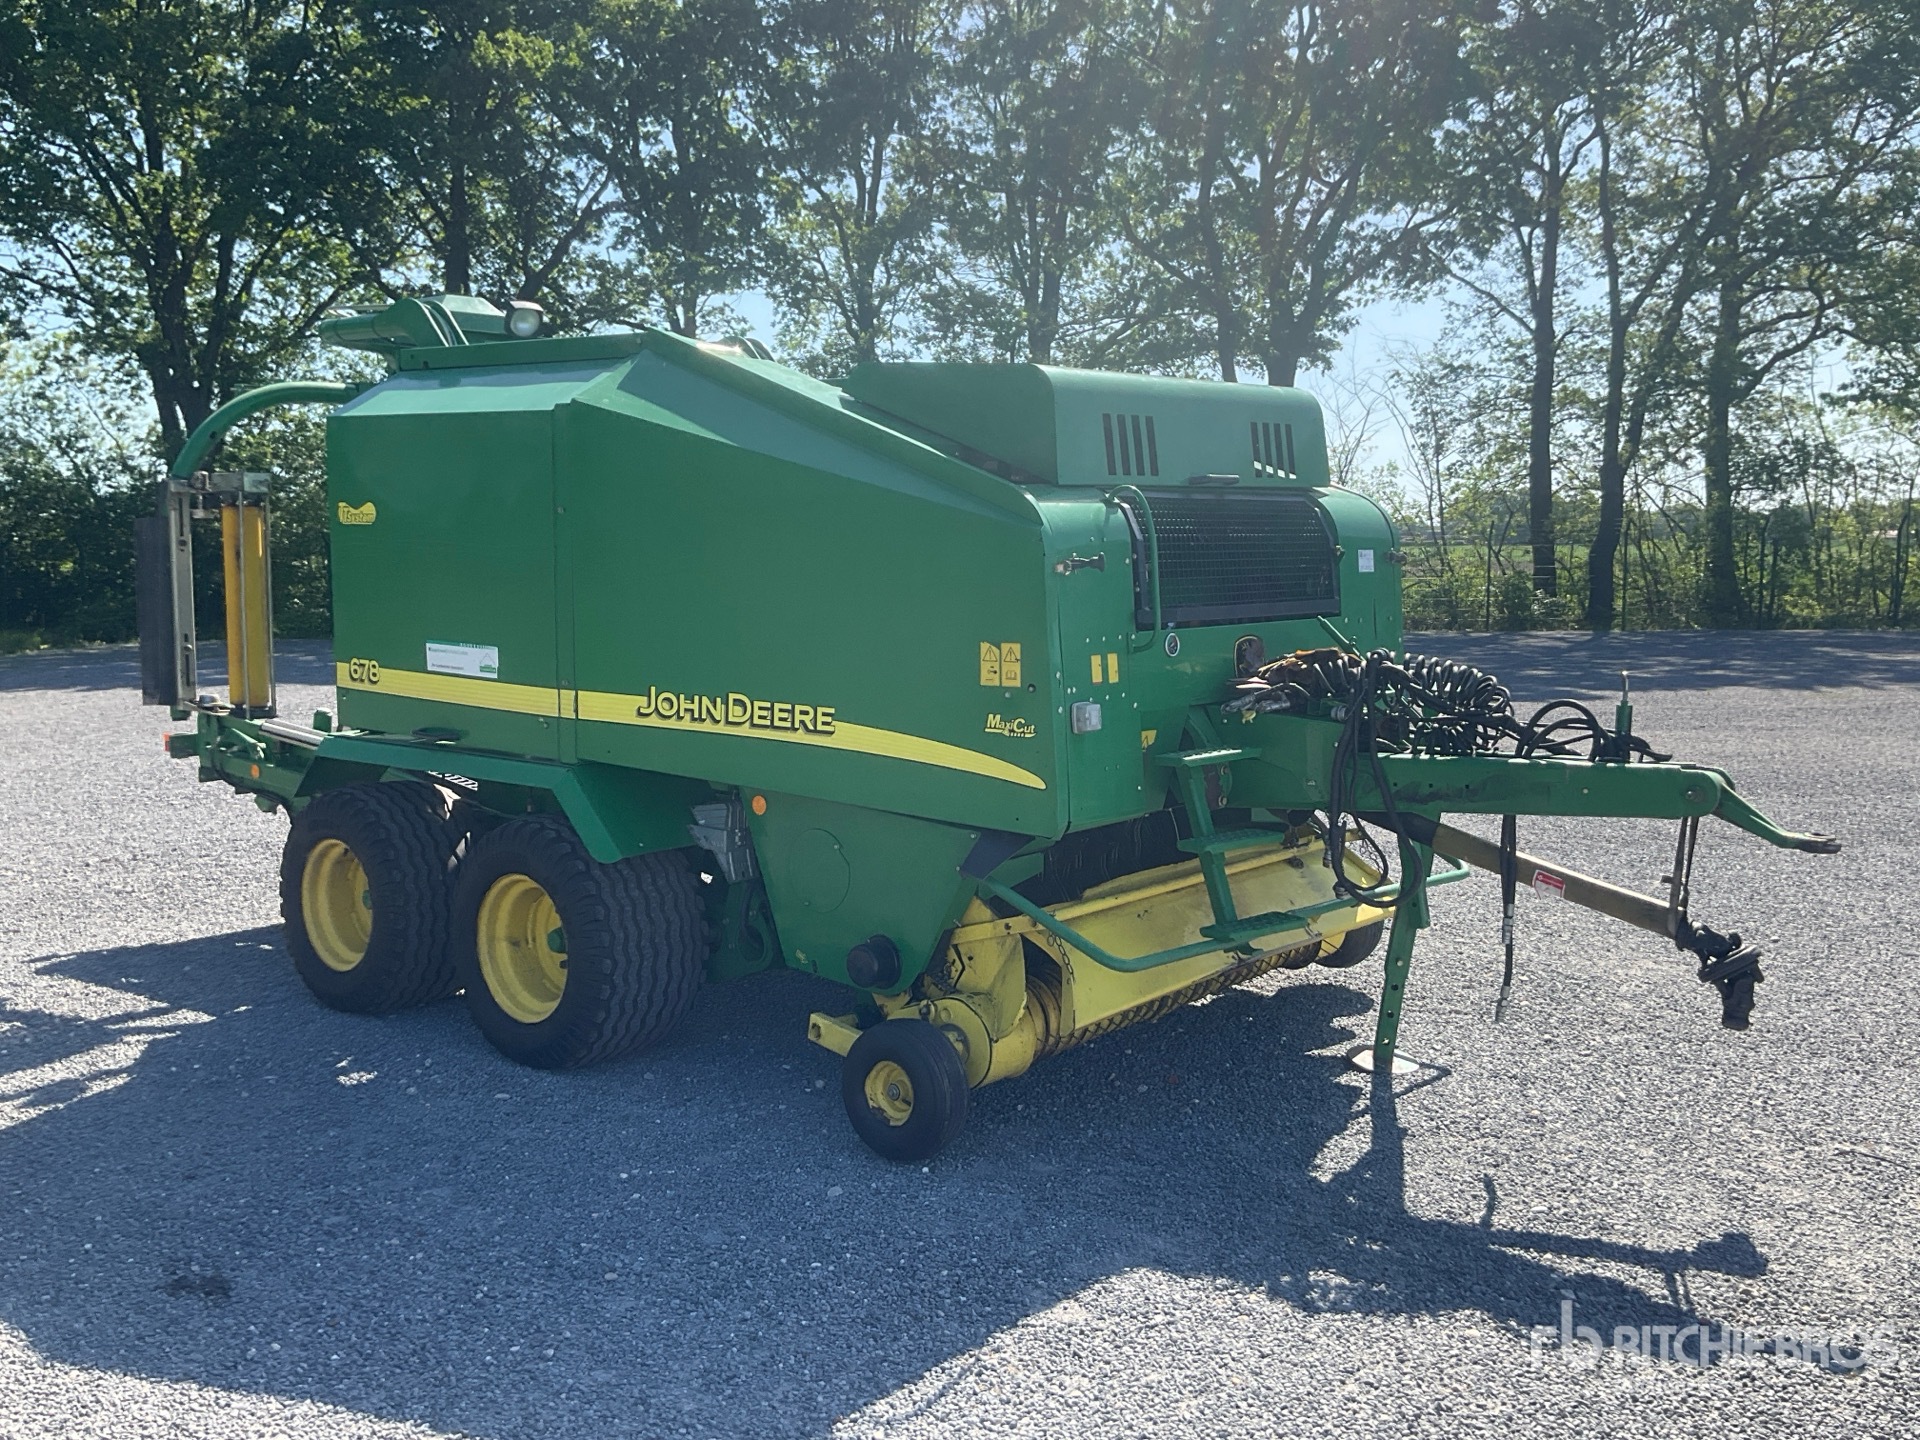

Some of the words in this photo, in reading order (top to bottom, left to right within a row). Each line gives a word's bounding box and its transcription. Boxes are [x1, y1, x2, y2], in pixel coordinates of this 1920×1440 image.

[350, 657, 380, 683] 678
[637, 685, 724, 723] JOHN
[727, 692, 836, 735] DEERE
